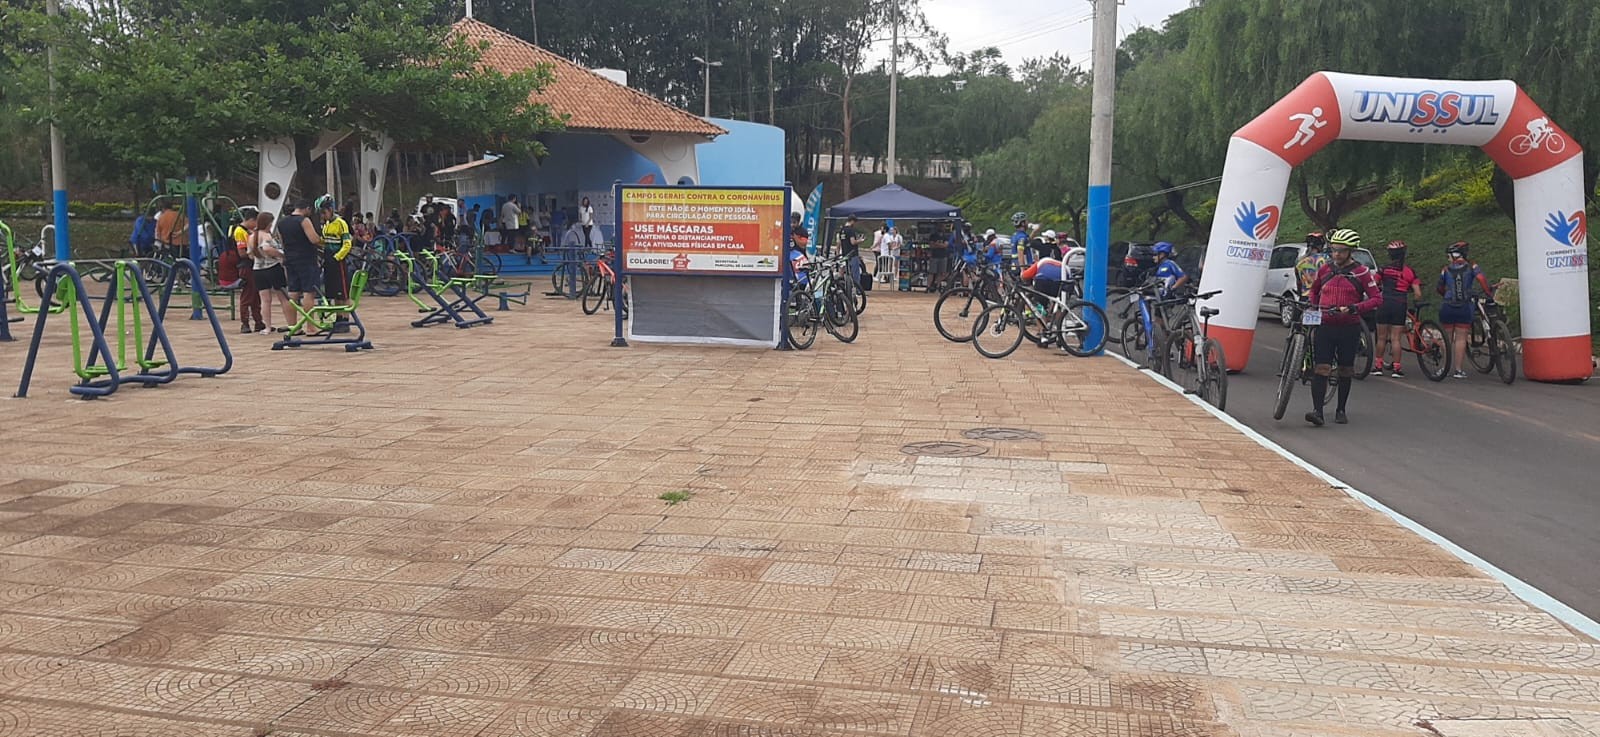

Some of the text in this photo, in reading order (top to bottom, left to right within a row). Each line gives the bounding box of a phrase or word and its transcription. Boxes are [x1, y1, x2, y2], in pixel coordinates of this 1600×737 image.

[1350, 90, 1500, 127] UNISSUL
[658, 192, 686, 200] GERAIS
[727, 193, 780, 201] CORONAVÍRUS
[667, 204, 683, 212] NÃO
[666, 212, 712, 220] CIRCULAÇÃO
[656, 223, 714, 234] MÁSCARAS
